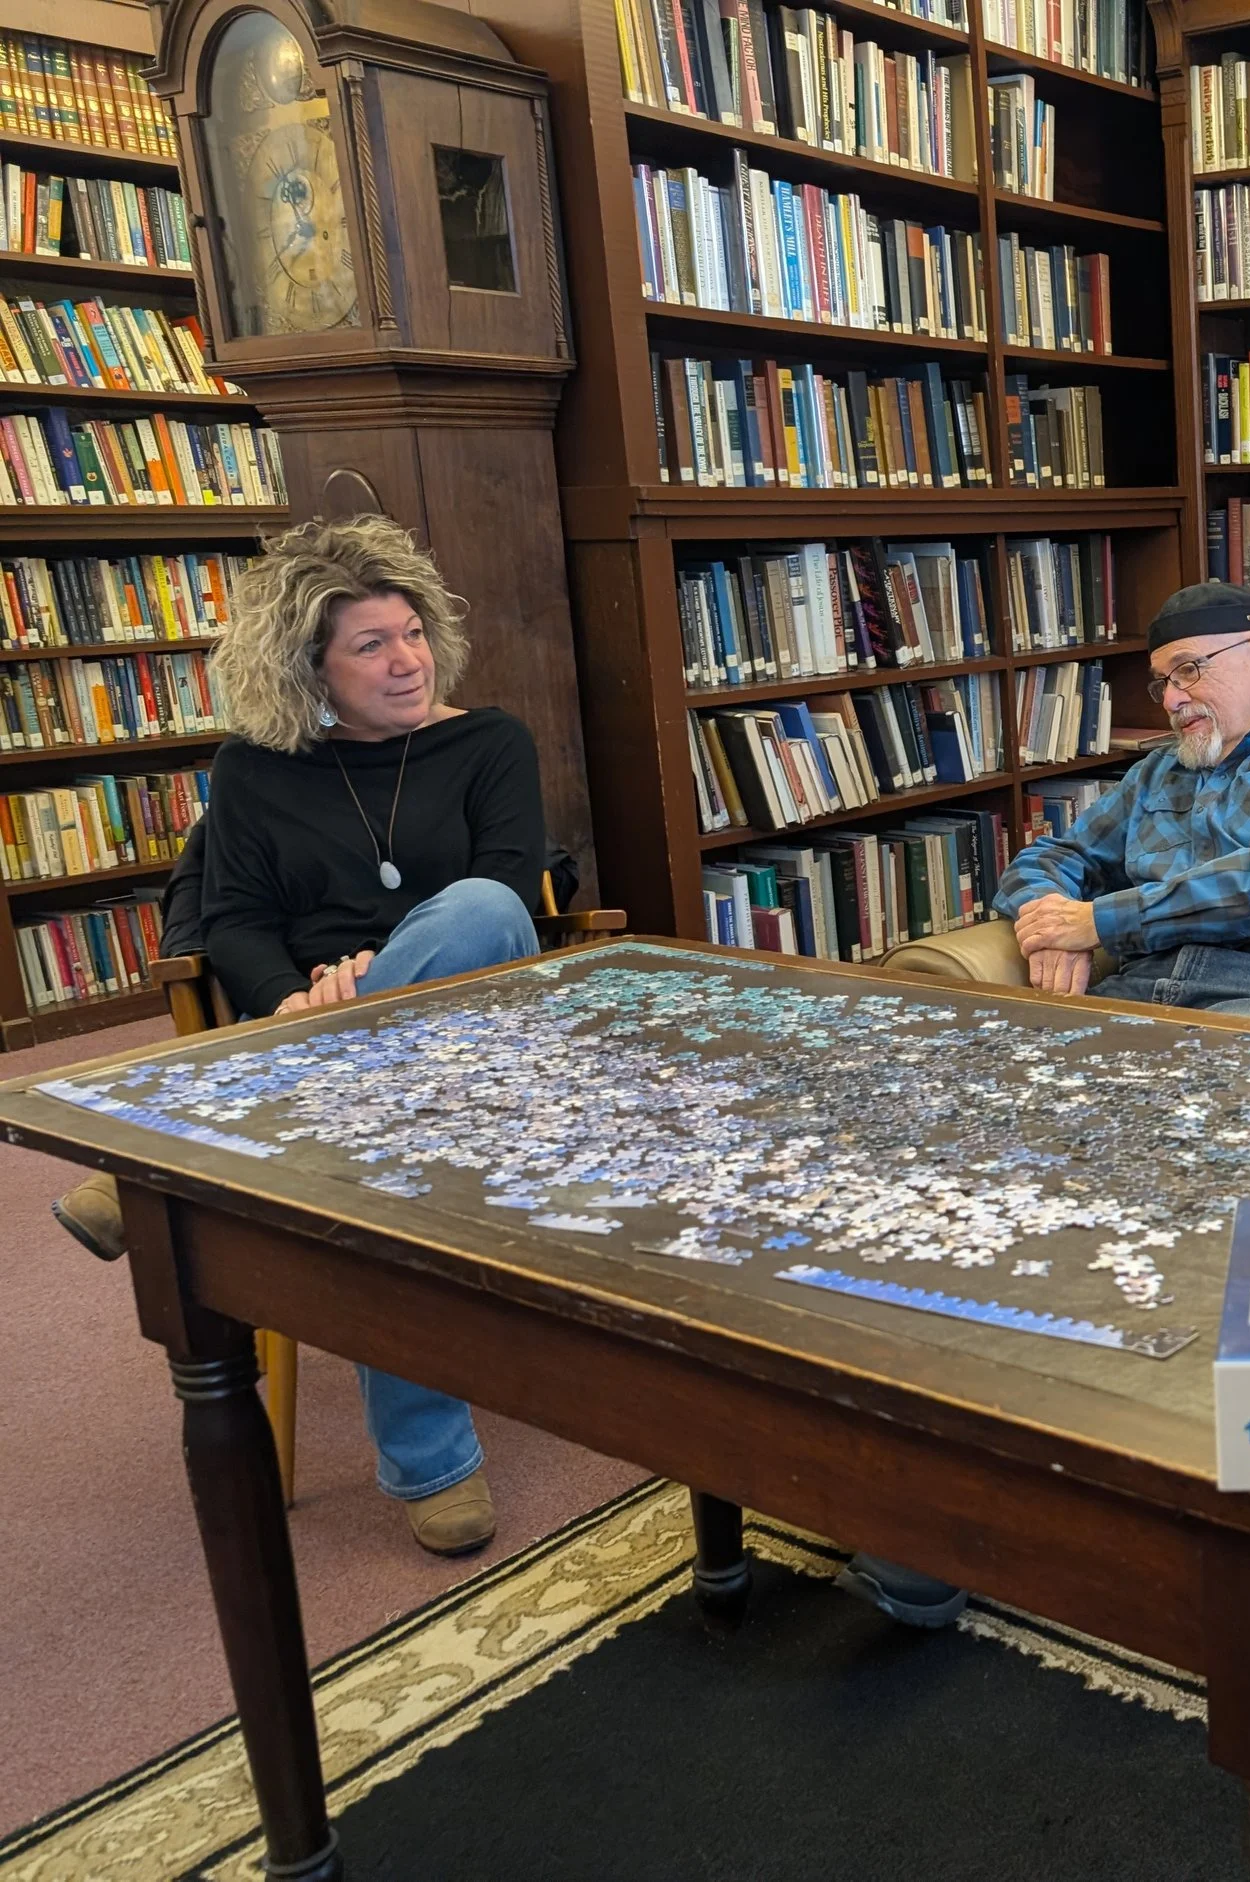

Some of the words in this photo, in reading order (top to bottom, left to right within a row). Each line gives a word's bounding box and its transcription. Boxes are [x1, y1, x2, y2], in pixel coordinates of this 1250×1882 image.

[740, 10, 752, 34] MIND
[742, 35, 756, 72] FACTOR
[822, 91, 830, 102] His
[786, 235, 797, 257] MILL
[814, 215, 826, 257] DEATH
[820, 259, 829, 275] IN
[822, 279, 831, 306] LIFE
[1218, 393, 1229, 419] BACKLASH
[220, 427, 230, 456] BRIDAL
[224, 456, 234, 478] CHAIR
[813, 571, 823, 586] Life
[828, 568, 840, 615] Passover
[833, 617, 844, 639] Plot
